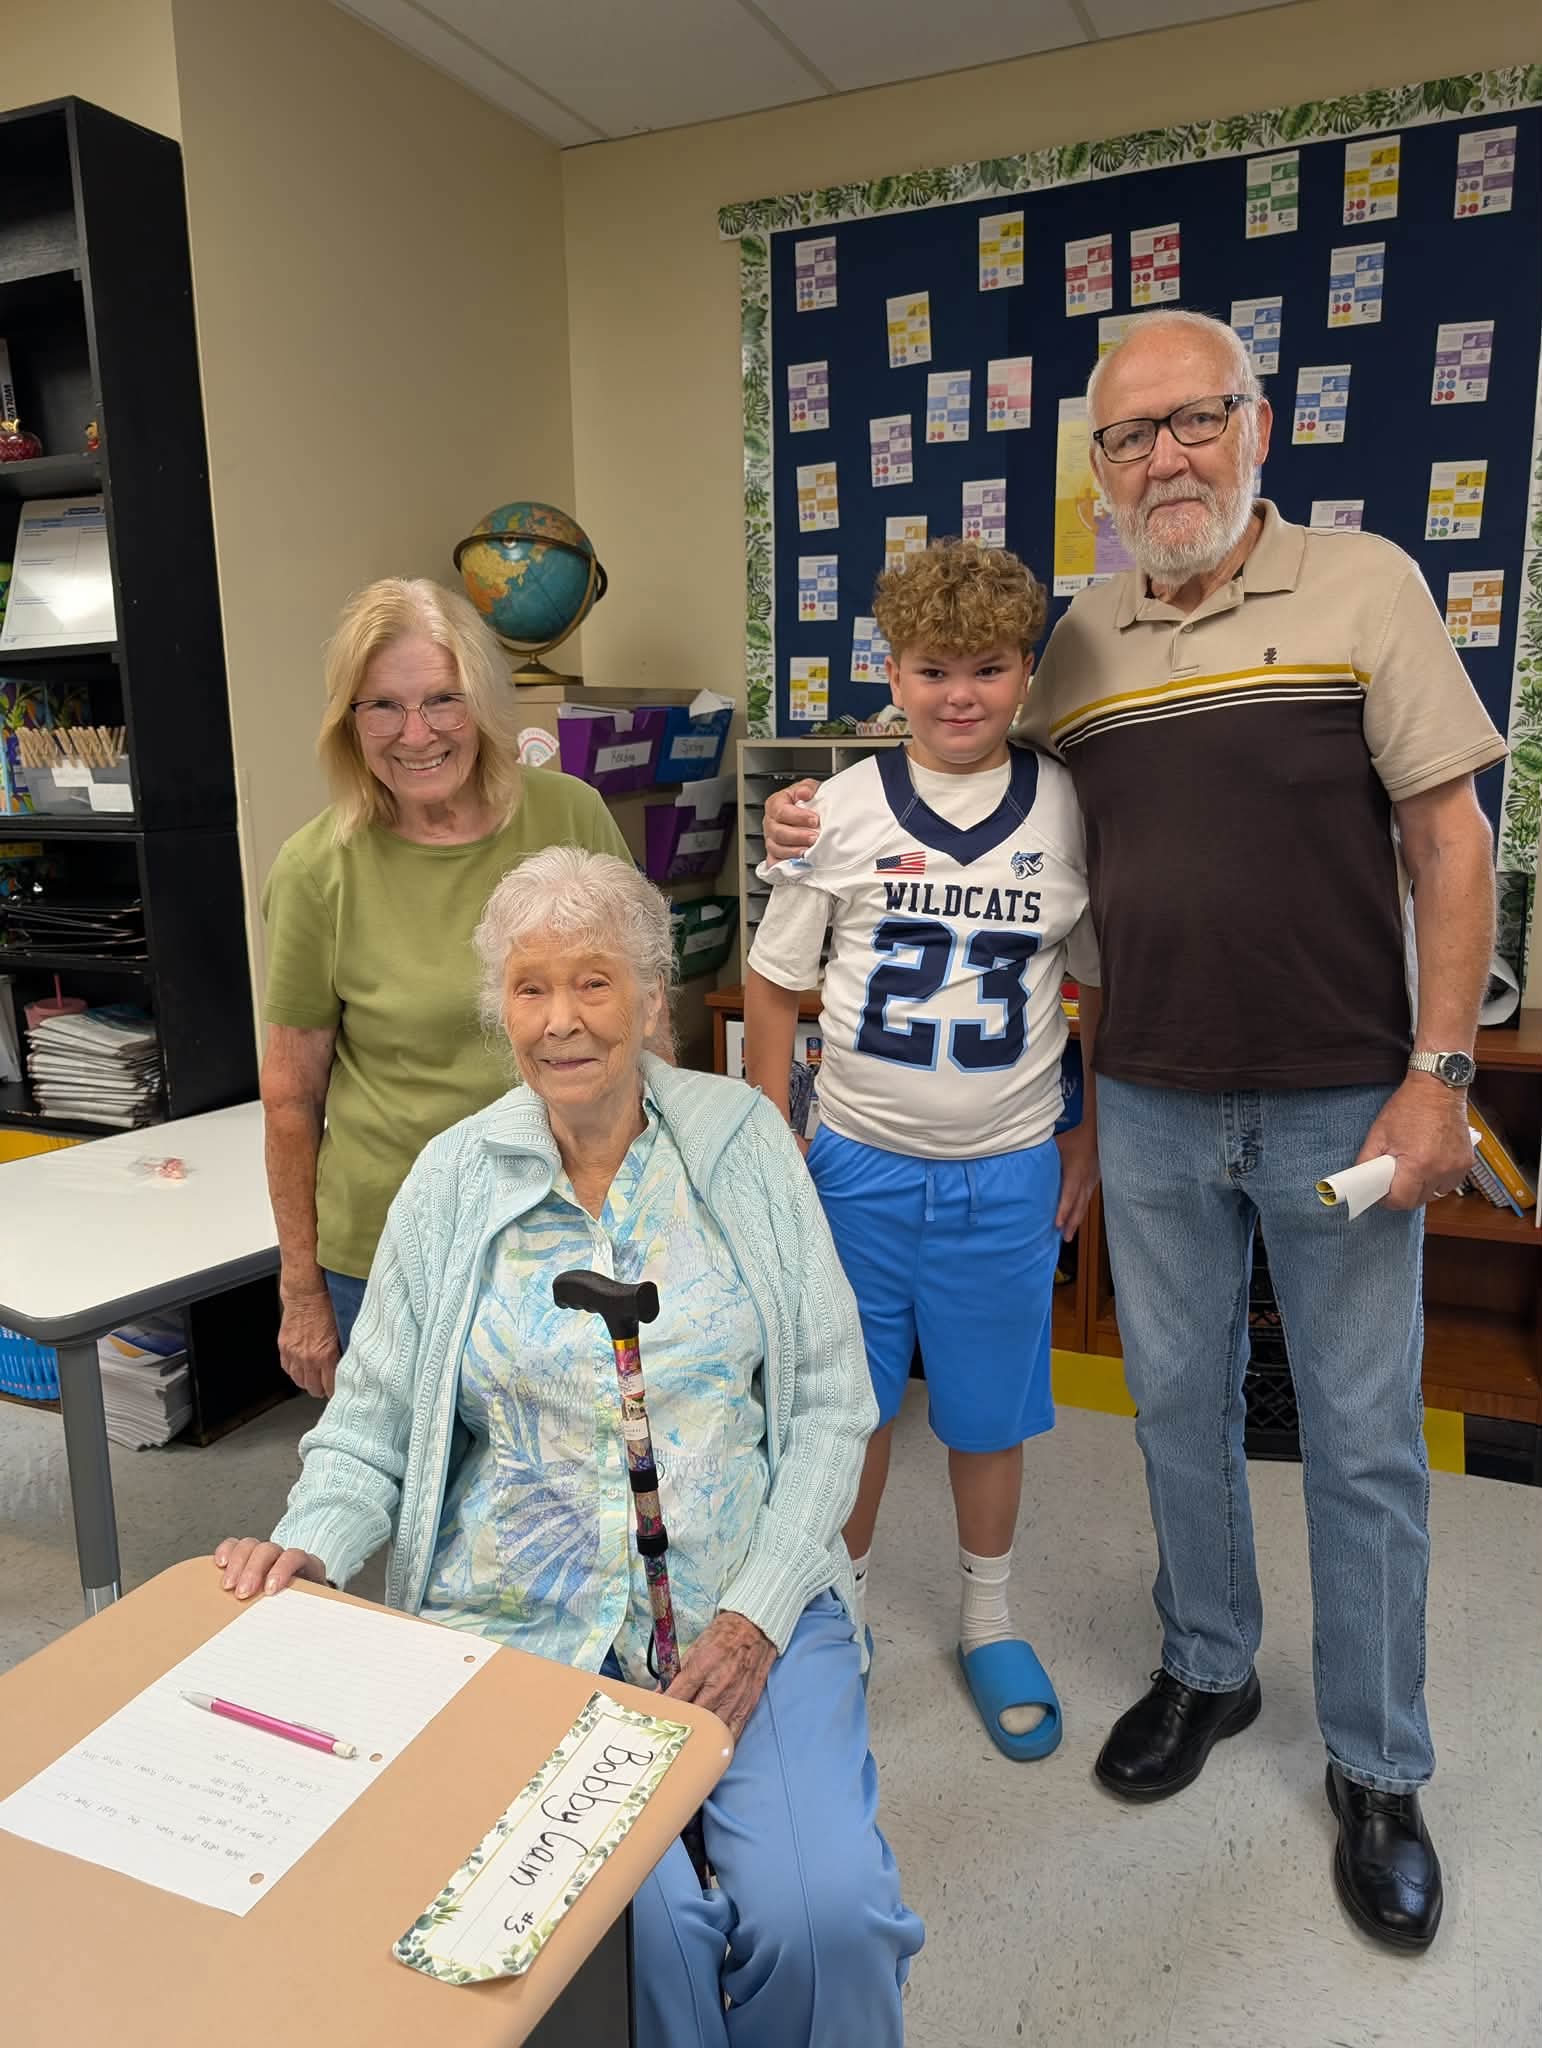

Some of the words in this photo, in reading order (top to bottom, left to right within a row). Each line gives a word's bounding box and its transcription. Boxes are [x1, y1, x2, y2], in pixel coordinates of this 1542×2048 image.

[883, 881, 1042, 924] WILDCATS
[854, 916, 1043, 1073] 23
[541, 1744, 654, 1824] Bobby
[503, 1910, 535, 1935] #3
